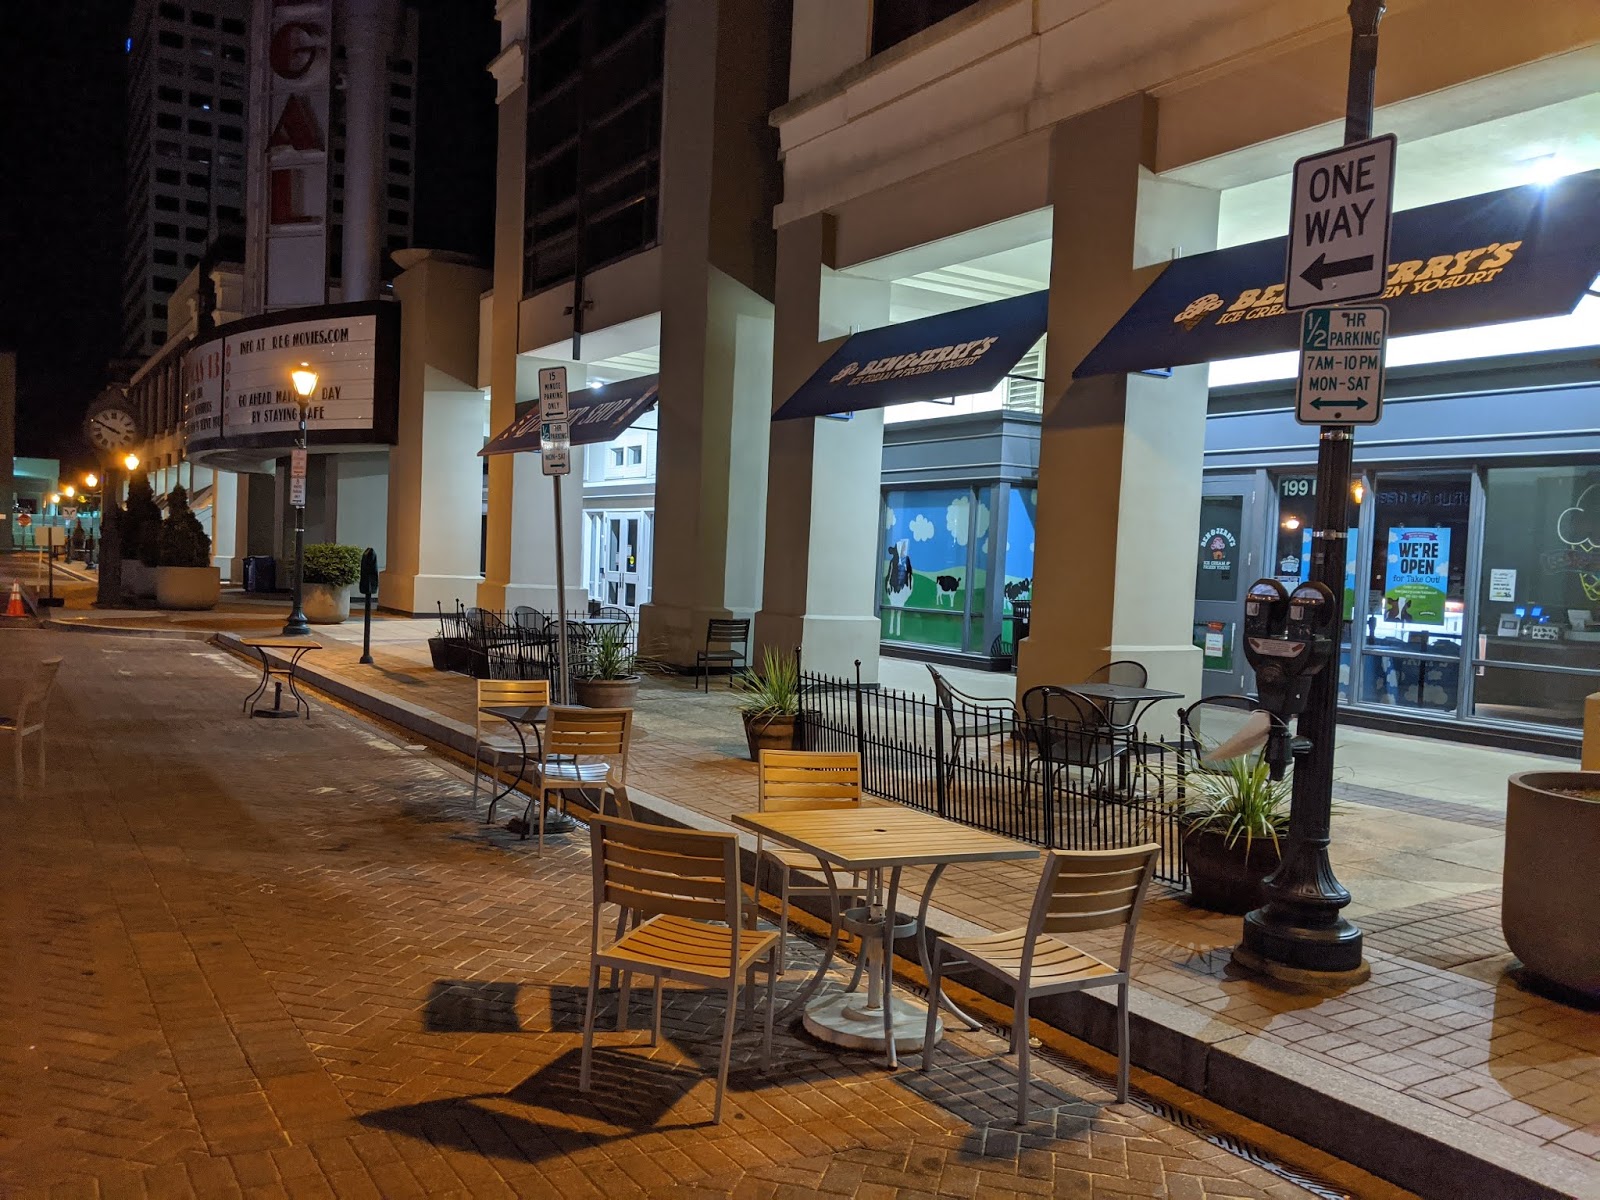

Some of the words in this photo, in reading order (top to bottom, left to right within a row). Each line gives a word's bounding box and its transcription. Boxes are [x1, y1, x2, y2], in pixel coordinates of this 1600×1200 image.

[265, 0, 326, 225] GAL
[1309, 155, 1376, 203] ONE
[1305, 198, 1376, 247] WAY
[1215, 310, 1246, 325] ICE
[1245, 304, 1287, 320] CREA
[1410, 268, 1503, 294] YOGURT
[1346, 312, 1367, 328] HR
[256, 338, 265, 351] AT
[292, 328, 349, 346] MOVIES.COM
[1330, 330, 1381, 347] PARKING
[901, 363, 936, 378] FROZEN
[937, 355, 982, 371] YOGURT
[549, 372, 556, 381] 15
[1308, 376, 1371, 392] MON-SAT
[544, 382, 561, 391] MINUTE
[249, 391, 272, 406] AHEAD
[322, 386, 341, 400] DAY
[544, 391, 563, 400] PARKING
[252, 411, 261, 423] BY
[264, 408, 298, 422] STAYING
[577, 398, 632, 425] SHOP
[551, 432, 567, 440] PARKING
[1398, 542, 1439, 558] WE'RE
[1400, 559, 1435, 575] OPEN
[1406, 575, 1423, 583] Take
